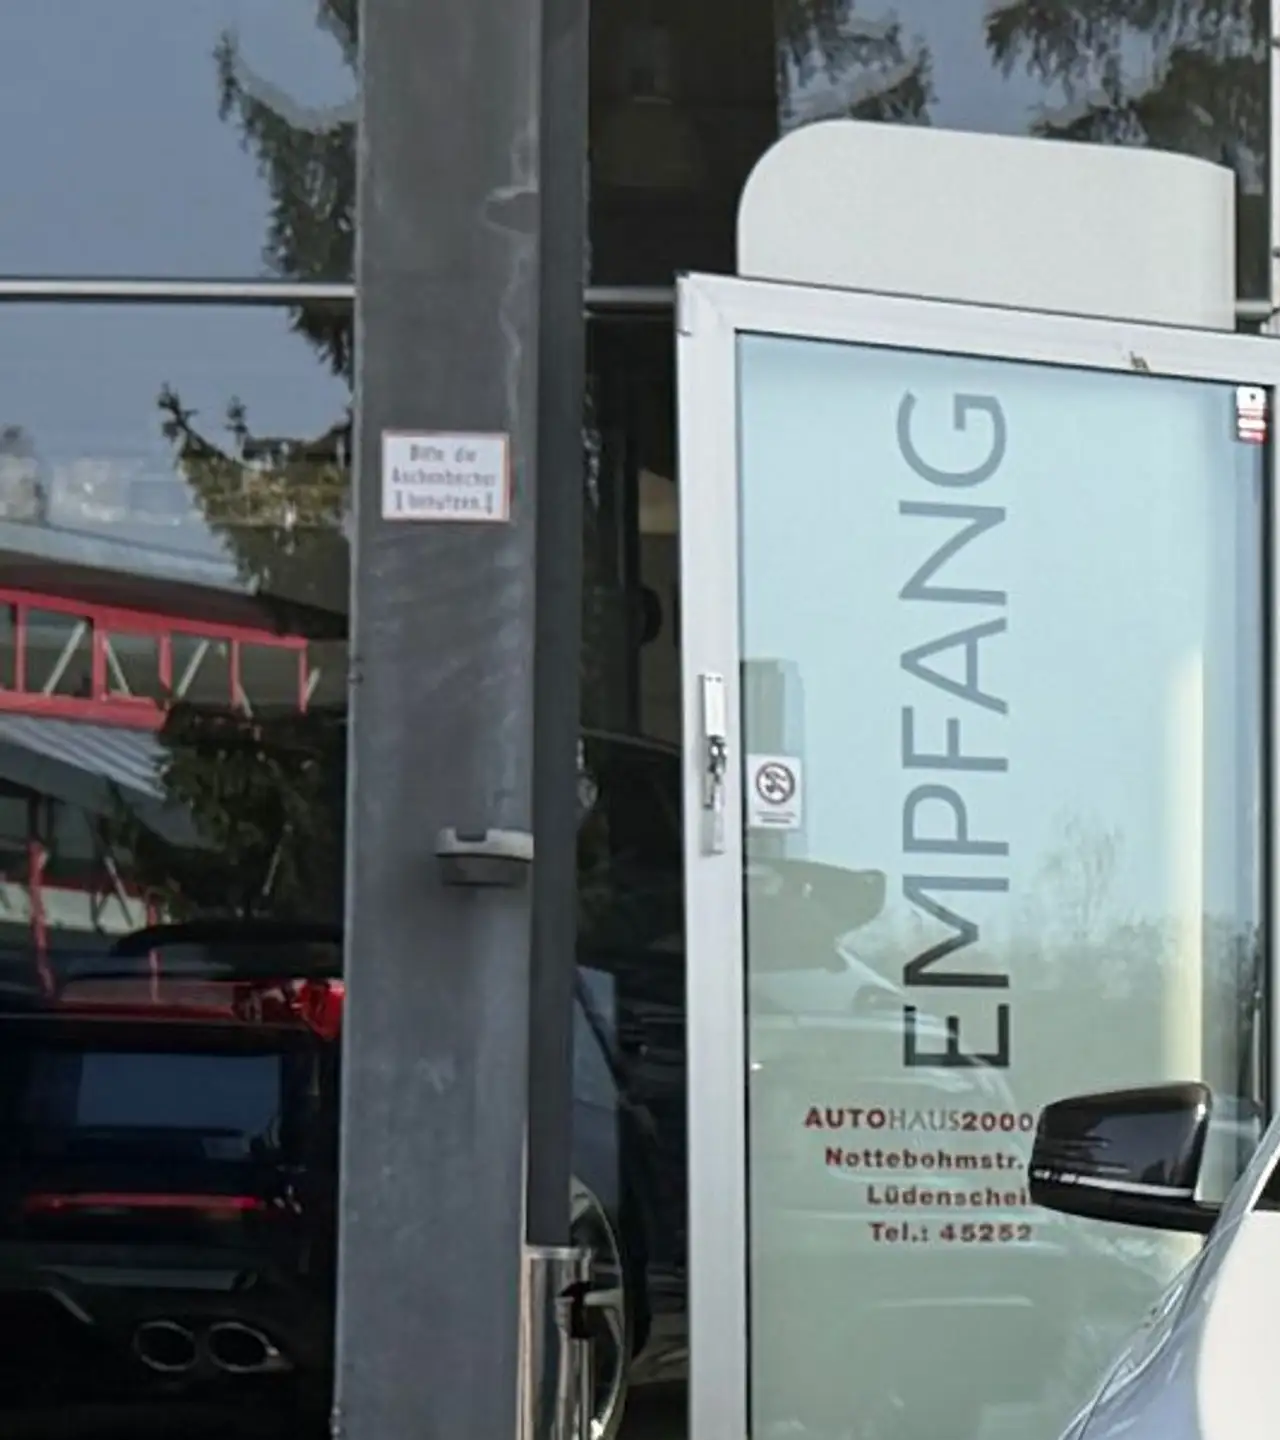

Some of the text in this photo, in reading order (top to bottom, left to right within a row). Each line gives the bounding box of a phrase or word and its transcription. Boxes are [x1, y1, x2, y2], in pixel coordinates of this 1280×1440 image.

[897, 389, 1010, 1068] EMPFANG
[804, 1107, 1034, 1132] AUTOHAUS2000
[825, 1147, 1024, 1170] Nottebohmstr.
[867, 1184, 1030, 1207] Lüdenschei
[868, 1221, 1034, 1243] Tel.: 45252
